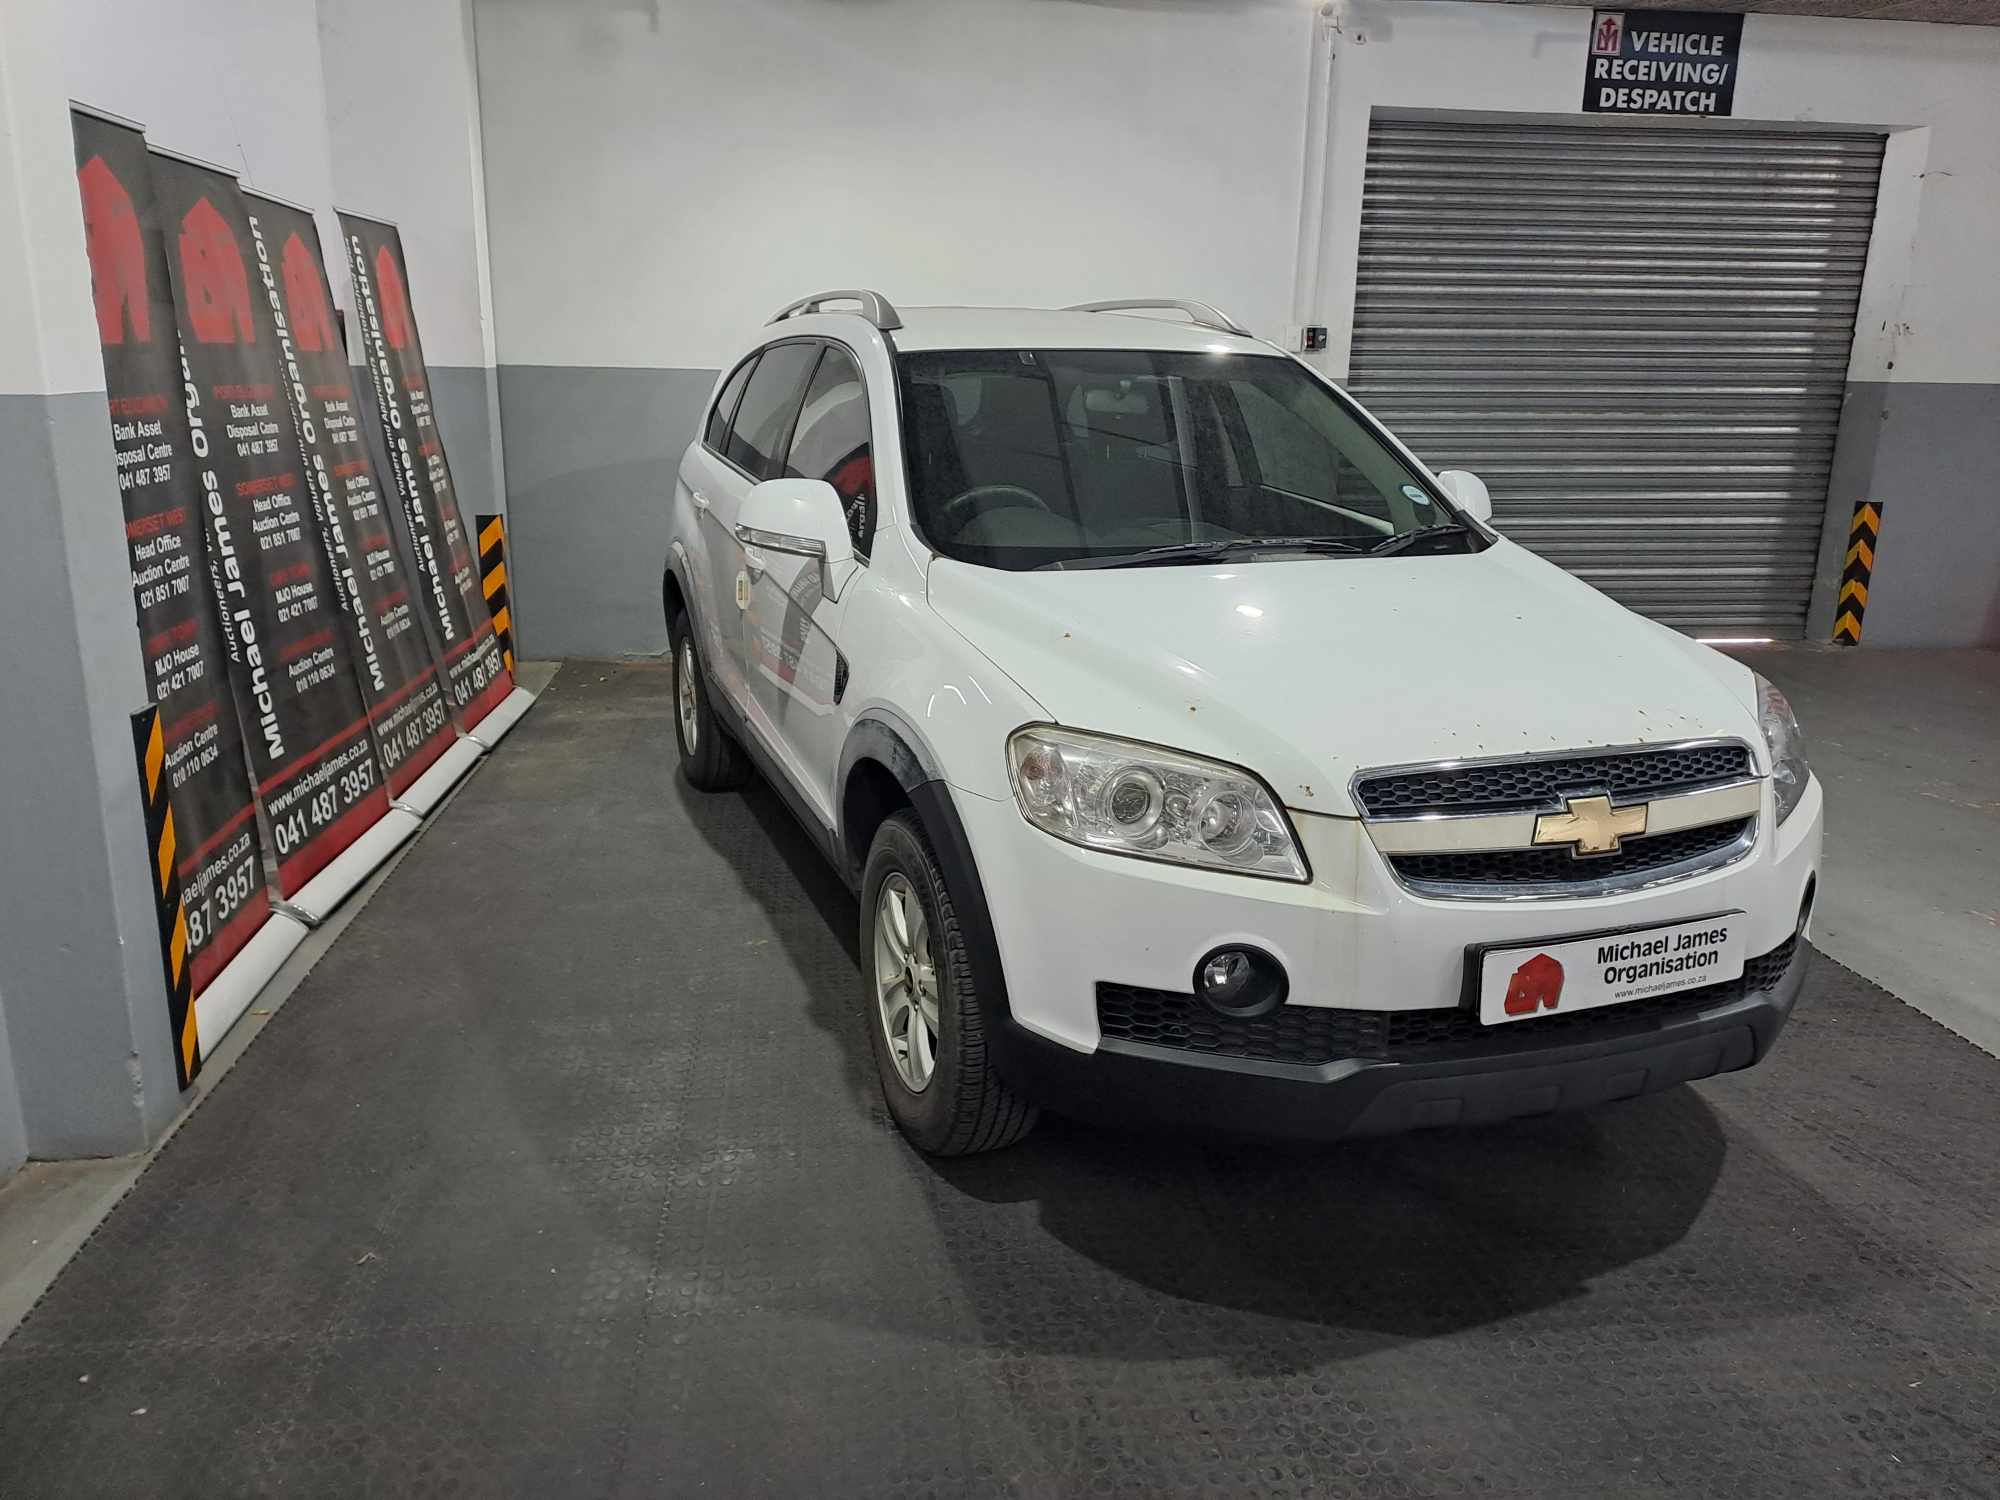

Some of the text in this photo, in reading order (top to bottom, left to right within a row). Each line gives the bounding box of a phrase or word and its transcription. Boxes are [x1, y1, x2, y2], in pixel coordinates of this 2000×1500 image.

[1631, 31, 1724, 56] VEHICLE
[1594, 58, 1729, 85] RECEIVING/
[1600, 87, 1717, 112] DESPATCH
[249, 216, 316, 444] Organisation
[352, 235, 401, 429] Organisation
[230, 404, 249, 419] Bank
[114, 420, 163, 441] Bank Asset
[226, 424, 259, 439] Disposal
[115, 442, 172, 469] isposal Centre
[237, 443, 249, 457] 041
[251, 440, 263, 454] 487
[119, 464, 171, 491] 041 487 3957
[398, 438, 426, 527] James
[253, 493, 292, 513] Head Office
[312, 454, 349, 559] James
[202, 470, 246, 598] James
[253, 515, 279, 533] Auction
[260, 535, 272, 550] 021
[273, 530, 286, 545] 851
[134, 540, 156, 562] Head
[157, 534, 182, 554] Office
[131, 554, 190, 587] Auction Centre
[420, 535, 455, 640] Michael
[140, 575, 190, 609] 021 851 7007
[342, 568, 385, 691] Michael
[155, 643, 200, 677] MJO House
[156, 660, 205, 700] 021 421 7007
[233, 609, 285, 760] Michael
[454, 677, 472, 705] 041
[473, 663, 487, 690] 487
[165, 723, 219, 770] Auction Centre
[383, 698, 446, 768] 041 487 3957
[268, 738, 368, 817] www.michaeljames.co.za
[275, 758, 375, 854] 041 487 3957
[215, 856, 255, 920] 3957
[1597, 927, 1728, 965] Michael James
[1604, 950, 1719, 985] Organisation
[1614, 975, 1707, 1000] www.michaeljames.co.za
